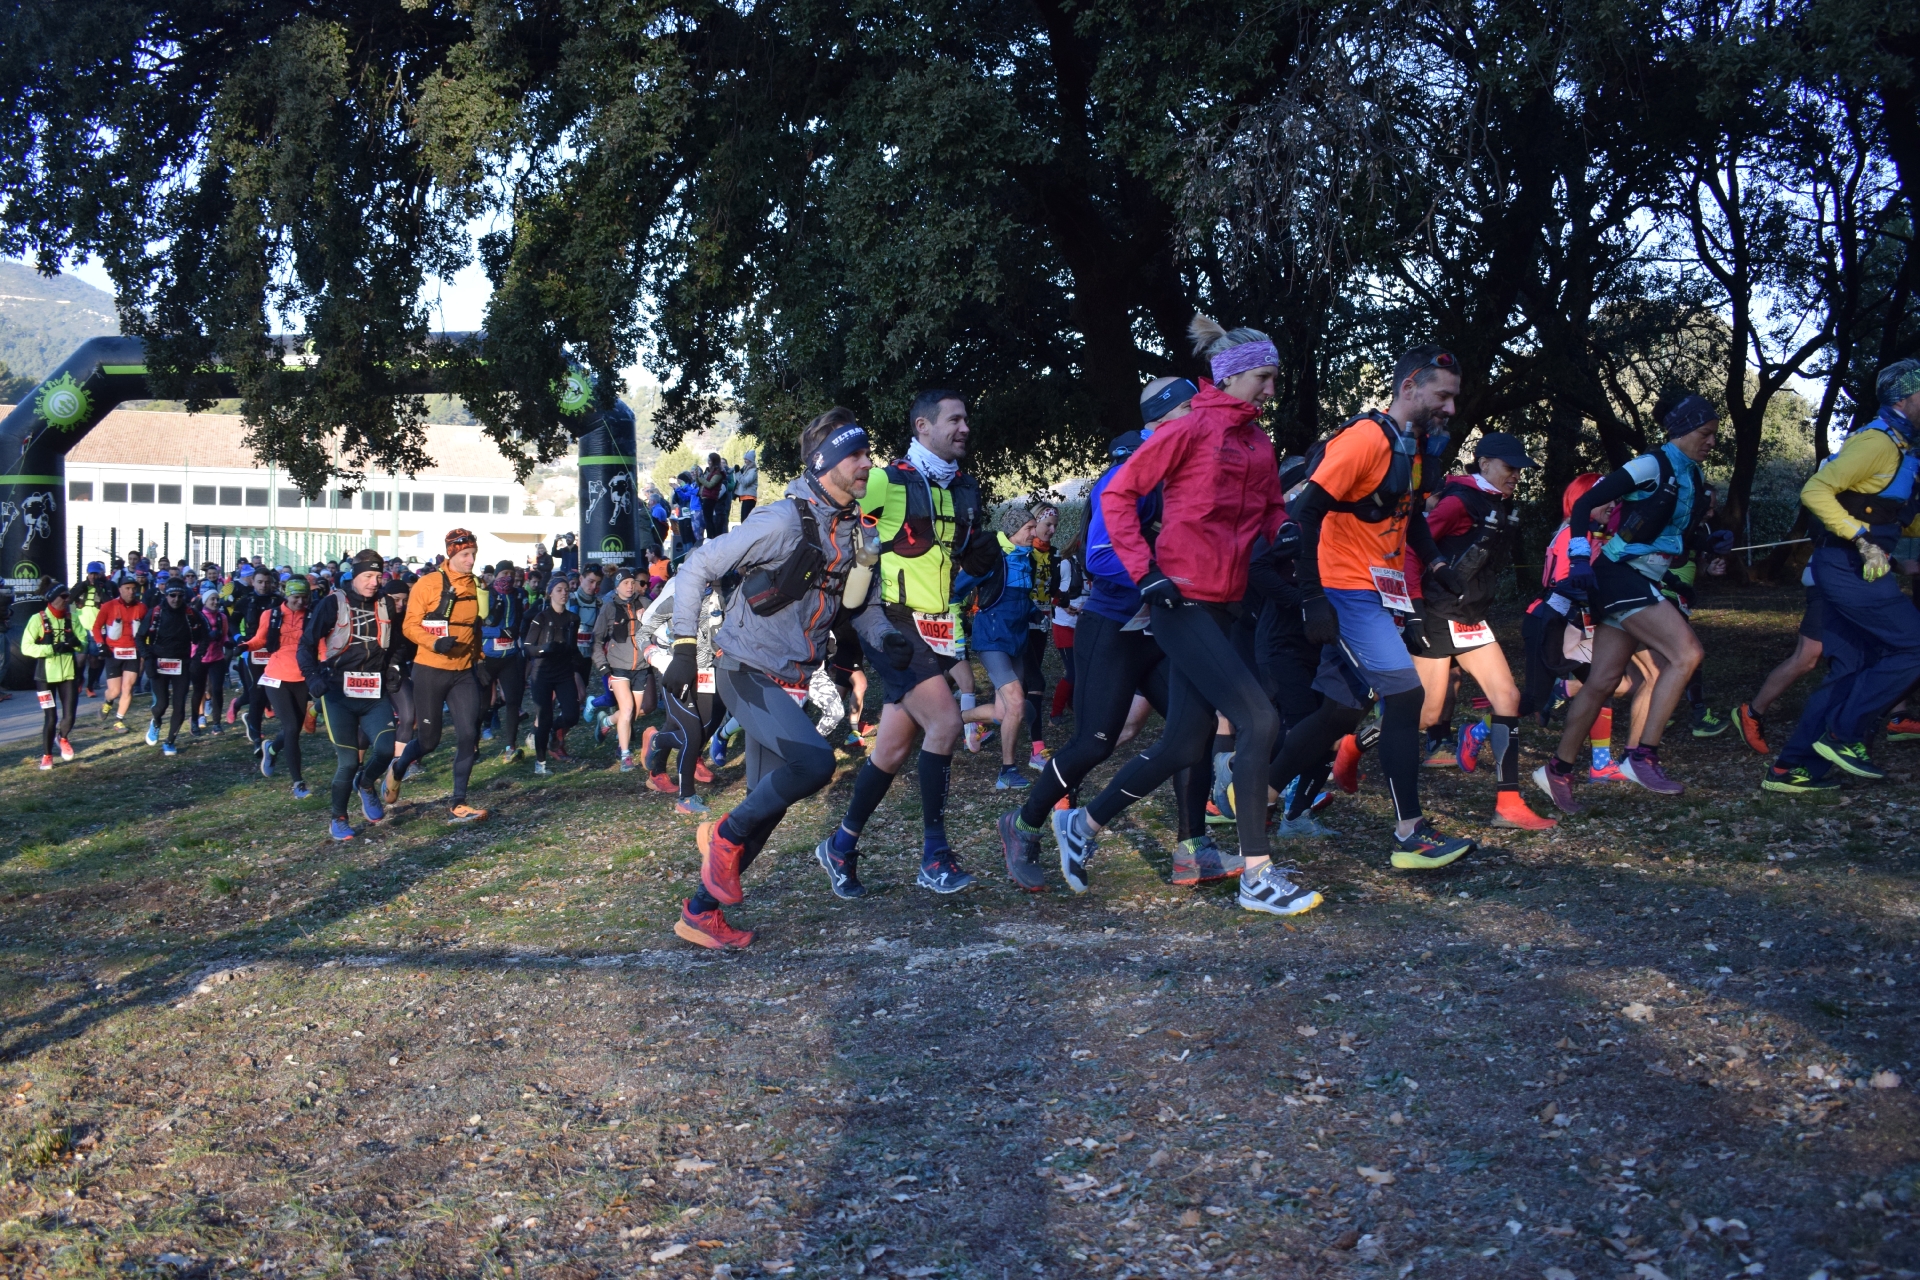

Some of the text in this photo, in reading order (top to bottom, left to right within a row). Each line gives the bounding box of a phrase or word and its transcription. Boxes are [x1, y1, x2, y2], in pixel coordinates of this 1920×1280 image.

[587, 551, 636, 559] ENDURANCE
[920, 621, 949, 639] 3092
[349, 677, 376, 688] 3049
